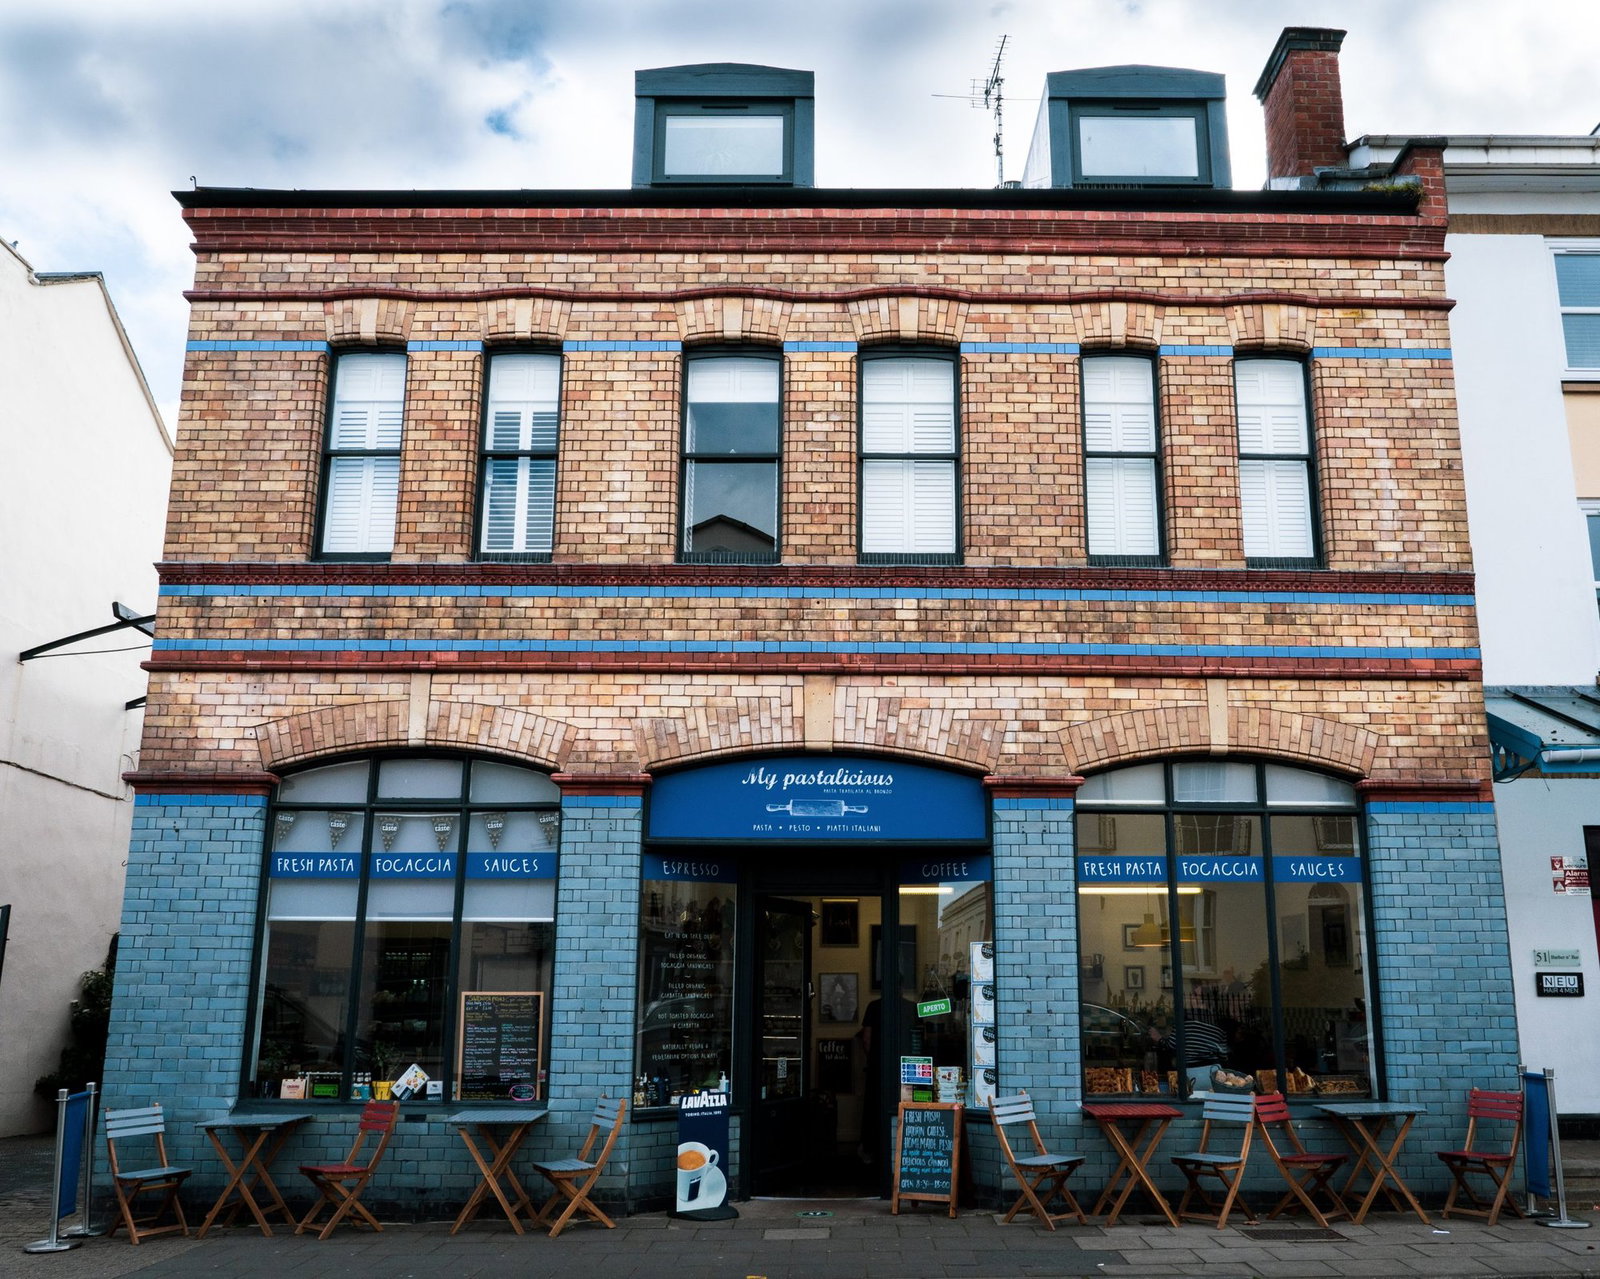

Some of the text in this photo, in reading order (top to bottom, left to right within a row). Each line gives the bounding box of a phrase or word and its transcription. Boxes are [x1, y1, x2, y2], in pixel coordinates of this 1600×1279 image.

[741, 766, 893, 790] My pastalicious
[788, 824, 811, 832] PESTO
[826, 824, 849, 832] PIATTI
[277, 858, 354, 872] FRESH PASTA
[376, 858, 451, 873] FOCACCIA
[484, 858, 539, 873] SAUCES
[662, 861, 719, 877] ESPRESSO
[922, 862, 969, 878] COFFEE
[1084, 862, 1162, 877] FRESH PASTA
[1182, 862, 1258, 876] FOCACCIA
[1290, 862, 1345, 877] SAUCES
[1536, 952, 1548, 962] 51
[1544, 976, 1576, 986] NEU
[923, 1003, 946, 1013] APERTO
[681, 1090, 728, 1109] LAVAZZA
[905, 1111, 922, 1123] FRESH
